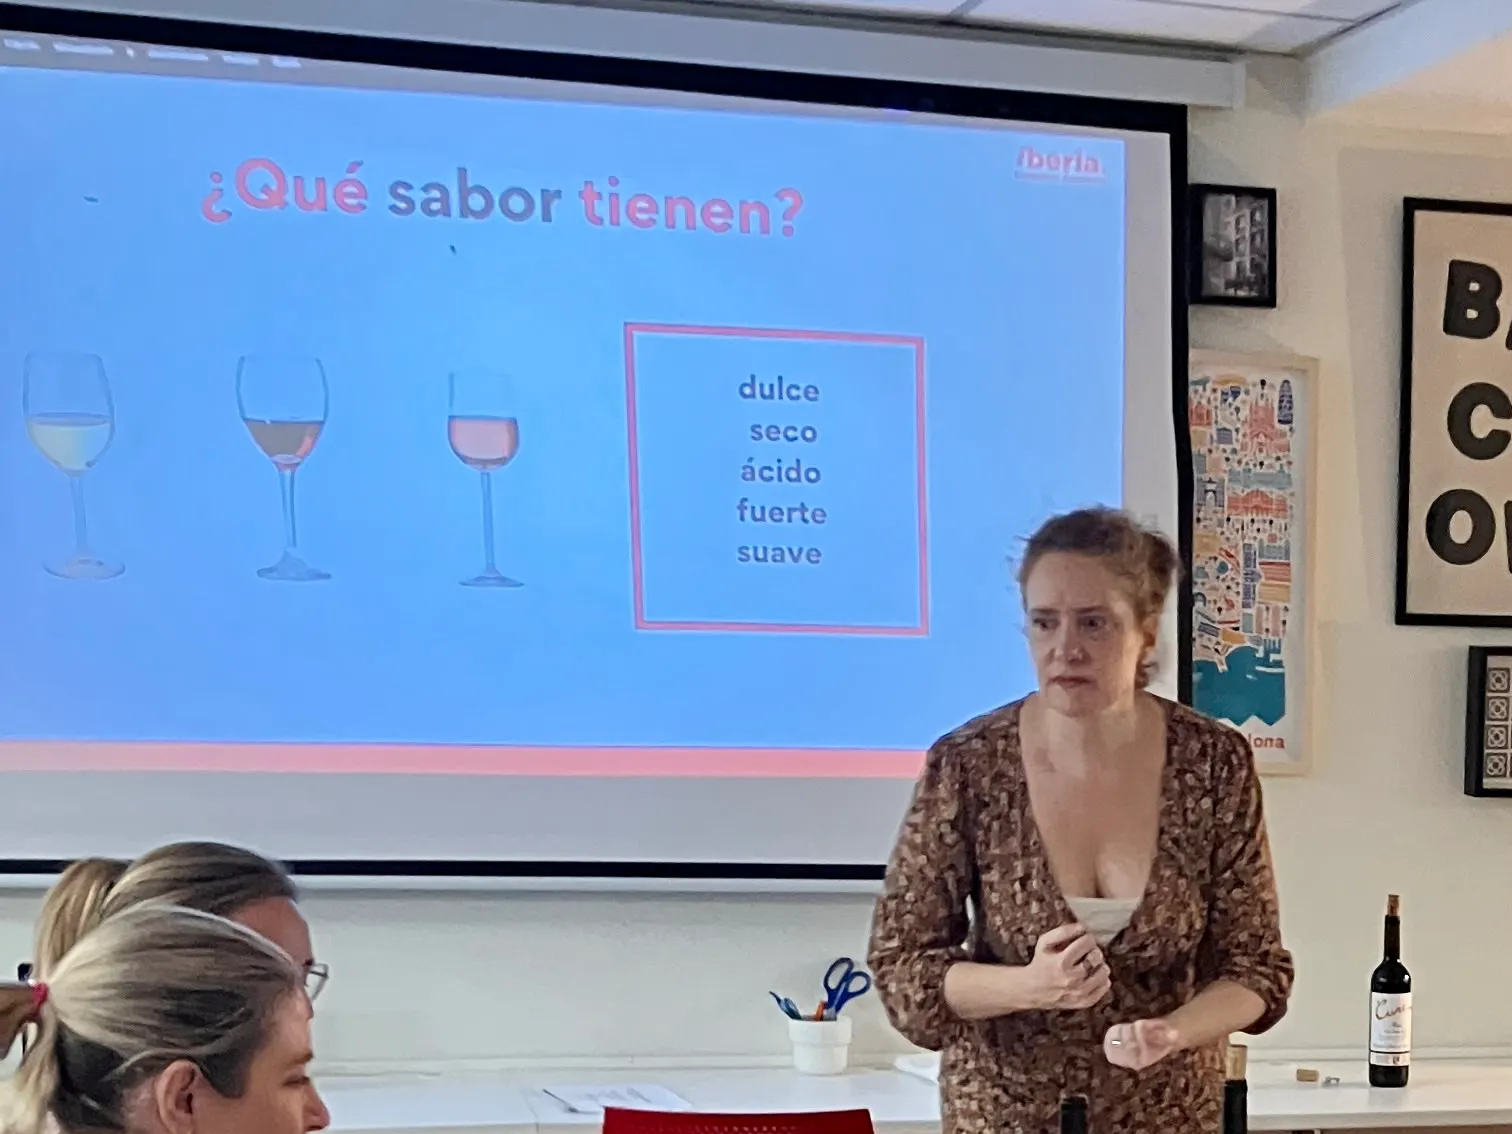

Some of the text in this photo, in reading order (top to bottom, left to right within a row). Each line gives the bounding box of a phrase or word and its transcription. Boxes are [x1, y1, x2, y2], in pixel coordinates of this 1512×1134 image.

[201, 156, 805, 238] ¿Qué sabor tienen?
[738, 373, 820, 402] dulce
[749, 423, 818, 443] seco
[740, 456, 822, 484] ácido
[735, 496, 828, 525] fuerte
[736, 544, 823, 565] suave
[1247, 732, 1285, 749] lona
